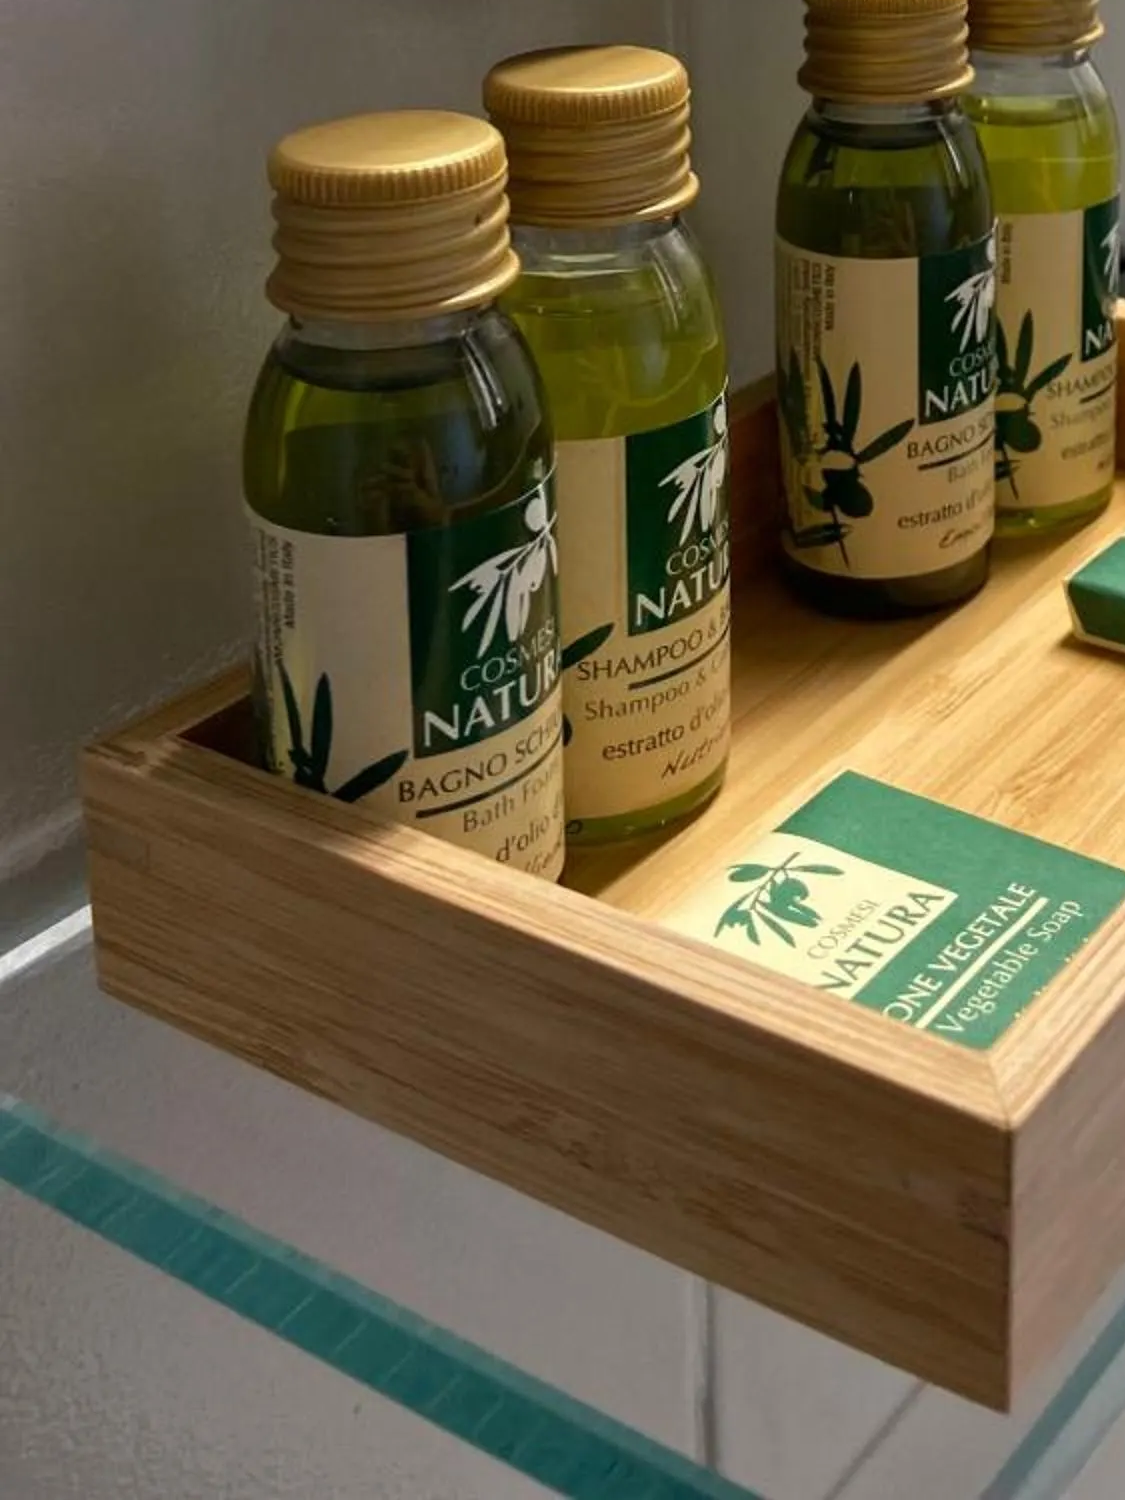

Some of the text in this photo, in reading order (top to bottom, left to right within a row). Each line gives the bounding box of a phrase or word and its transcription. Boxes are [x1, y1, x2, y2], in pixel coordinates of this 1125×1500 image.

[906, 424, 976, 460] BAGNO
[576, 628, 703, 682] SHAMPOO
[584, 680, 690, 722] Shampoo
[602, 724, 685, 762] estratto
[398, 752, 508, 803] BAGNO
[463, 793, 515, 833] Bath
[806, 899, 881, 960] COSMESI
[812, 891, 946, 991] NATURA
[927, 881, 1037, 972] VEGETALE
[936, 943, 1039, 1033] Vegetable
[1025, 900, 1084, 942] Soap
